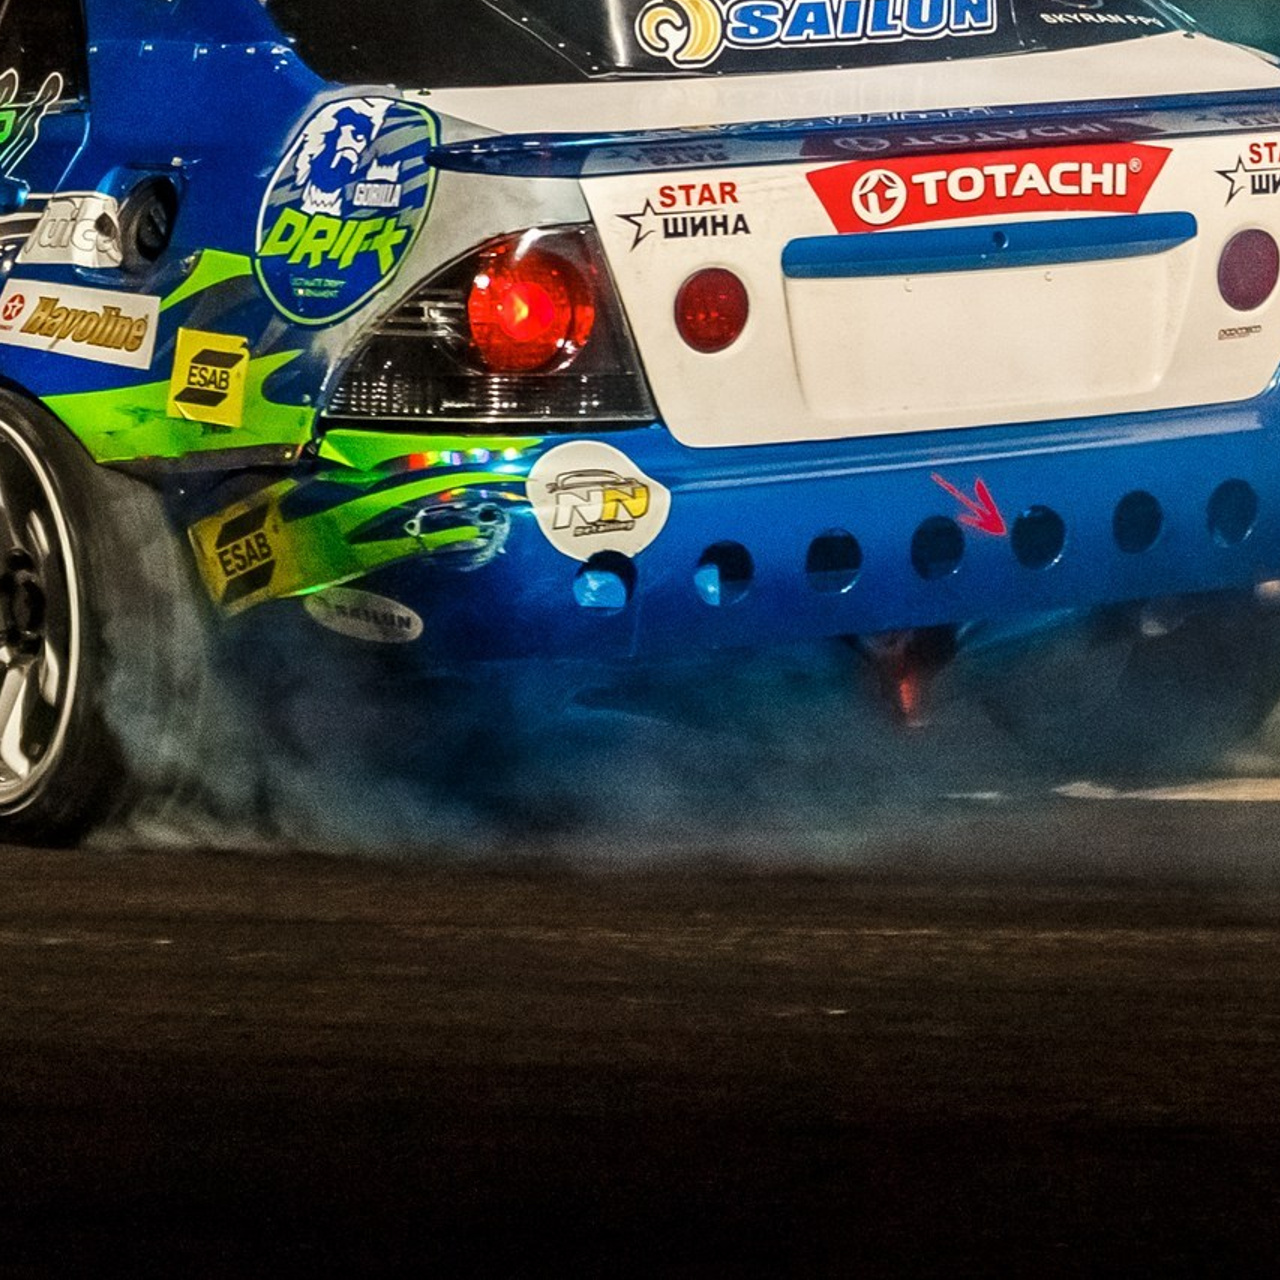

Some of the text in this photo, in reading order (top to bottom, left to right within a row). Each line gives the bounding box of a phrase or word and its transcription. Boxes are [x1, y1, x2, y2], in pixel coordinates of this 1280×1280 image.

[1248, 141, 1280, 165] ST
[658, 181, 739, 209] STAR
[258, 206, 408, 276] DRIFT
[662, 213, 751, 239] ШИНА
[20, 296, 149, 352] Havoline
[186, 364, 231, 391] ESAB
[551, 485, 650, 531] NN
[217, 530, 273, 578] ESAB
